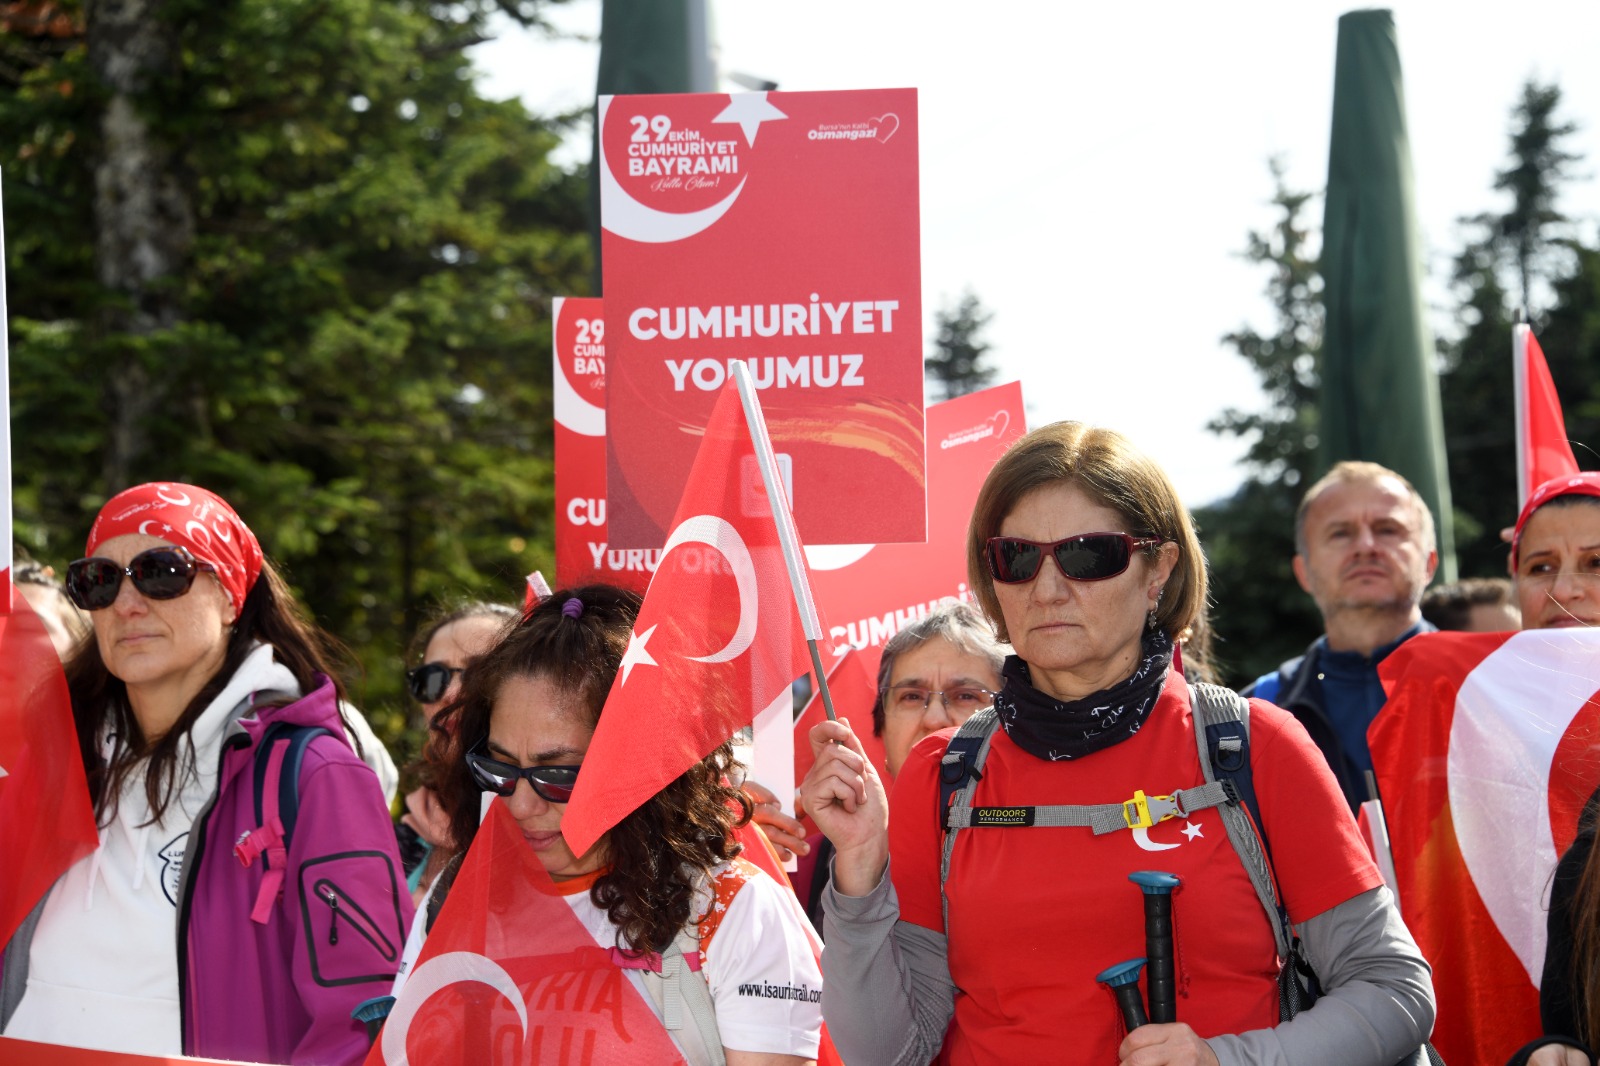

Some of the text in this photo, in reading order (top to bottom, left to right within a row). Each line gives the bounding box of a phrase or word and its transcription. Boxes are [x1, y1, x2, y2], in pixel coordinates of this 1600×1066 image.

[630, 114, 700, 142] 29 EKİM
[808, 127, 878, 140] Osmangazi
[628, 138, 738, 156] CUMHURİYET
[629, 156, 738, 176] BAYRAMI
[628, 292, 899, 341] CUMHURİYET
[575, 318, 605, 344] 29
[979, 809, 1027, 818] OUTDOORS
